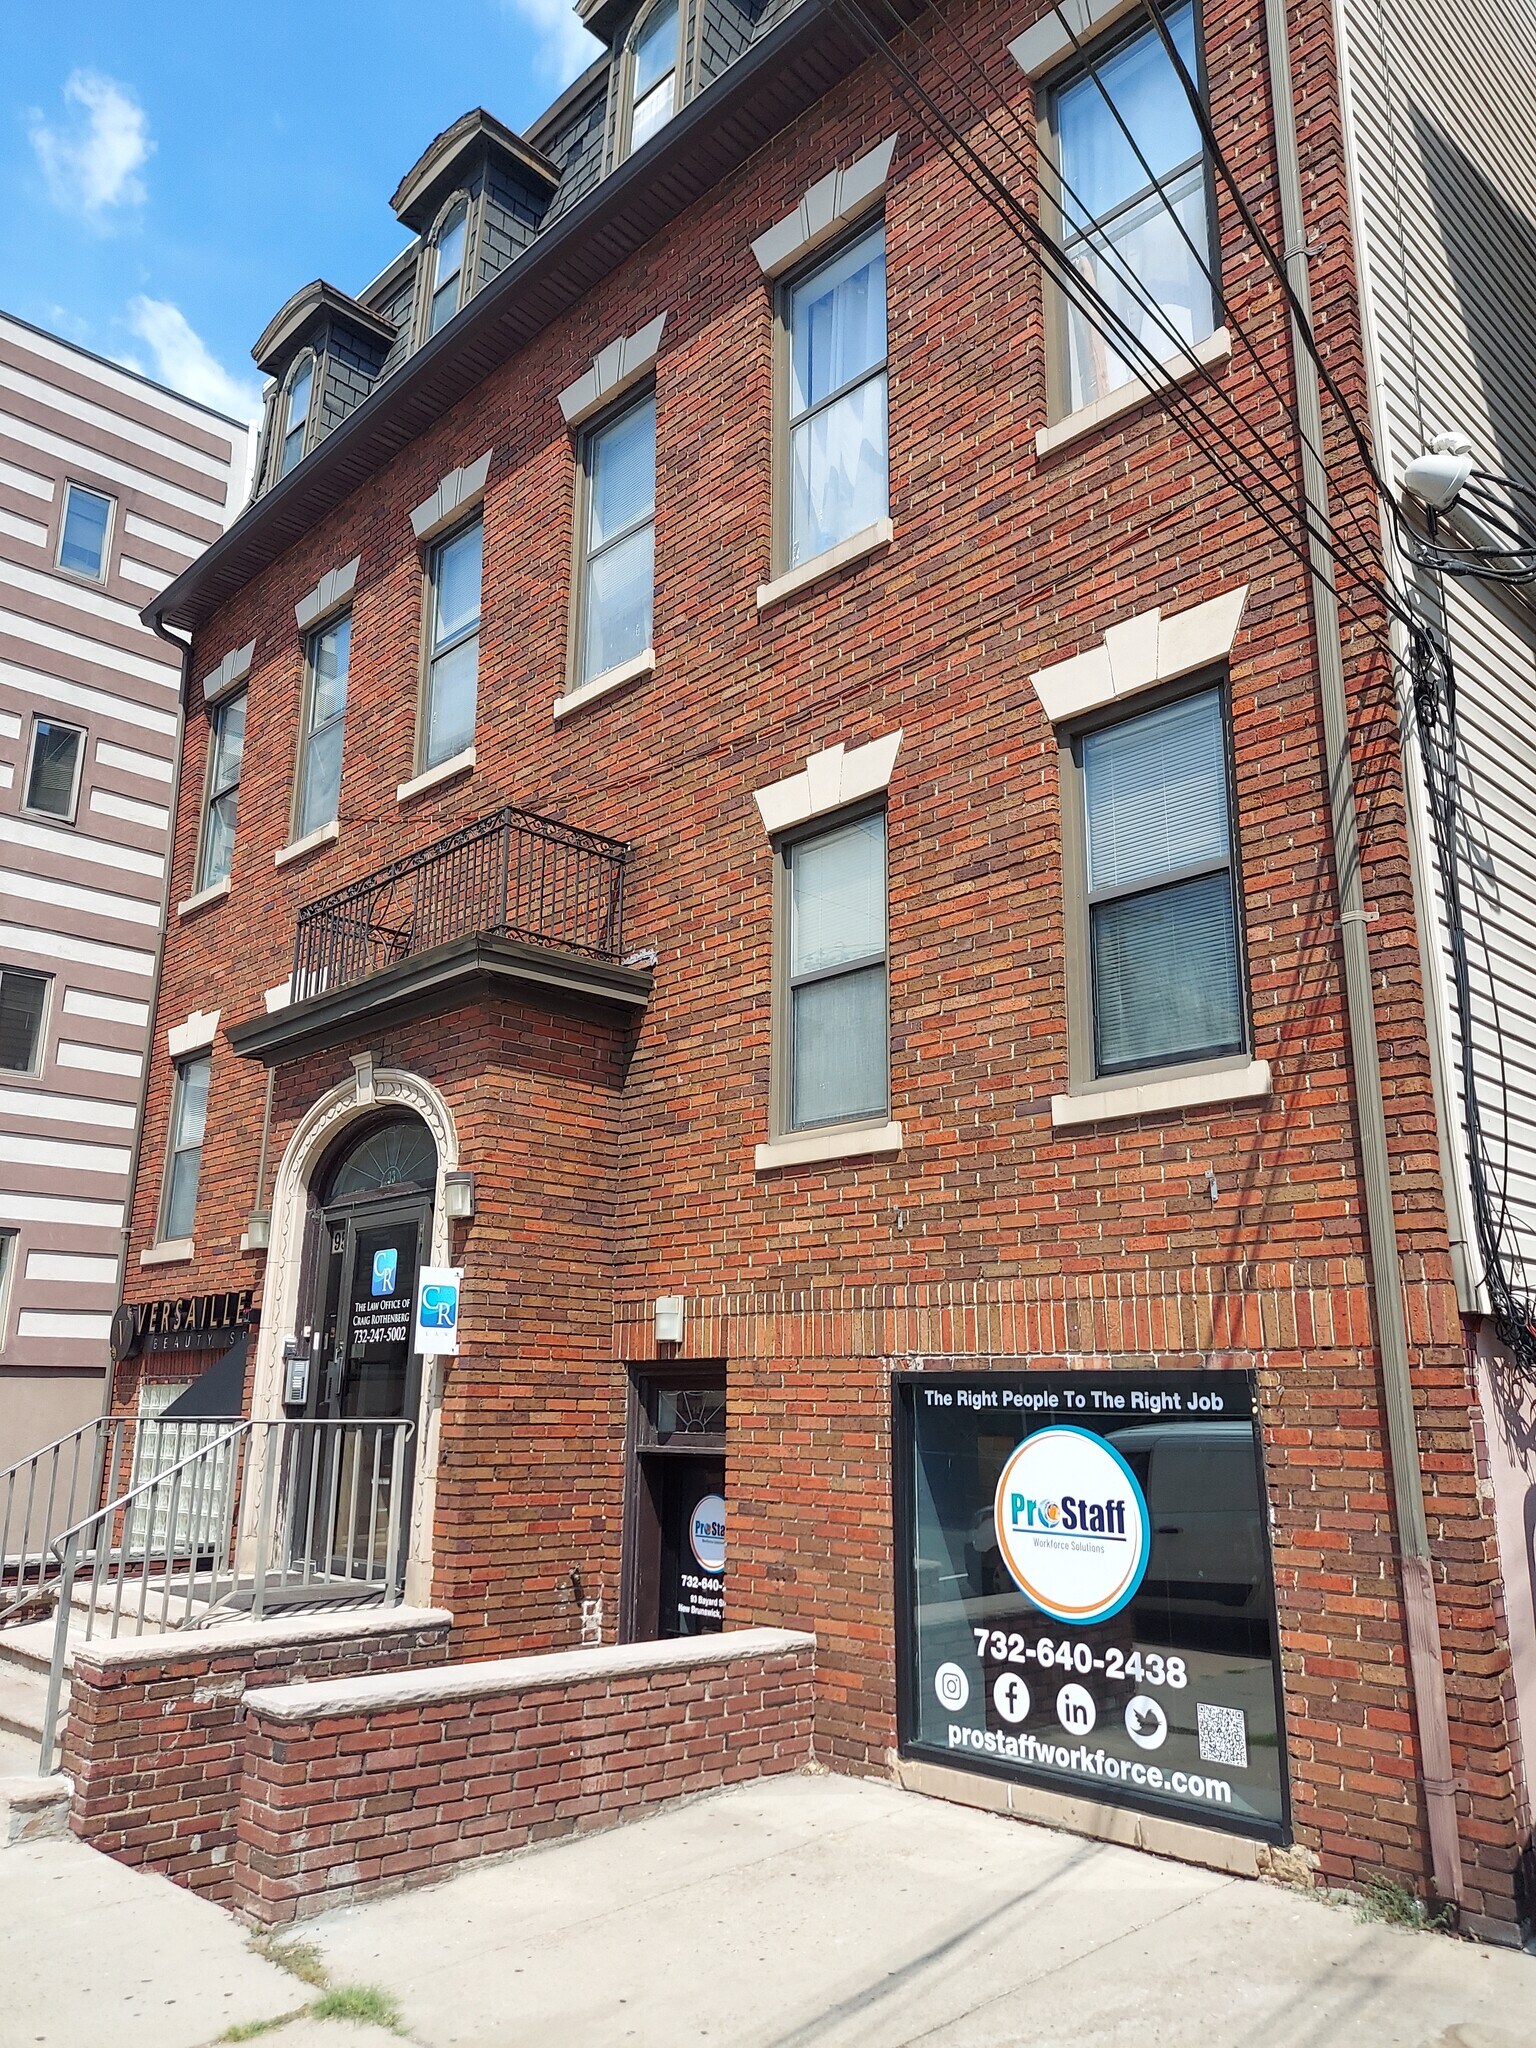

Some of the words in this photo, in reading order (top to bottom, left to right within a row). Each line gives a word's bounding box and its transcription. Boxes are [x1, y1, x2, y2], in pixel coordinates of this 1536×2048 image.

[353, 1315, 370, 1326] CRAIG
[371, 1313, 410, 1325] ROTHENBERG
[152, 1334, 214, 1350] BEAUTY
[354, 1326, 406, 1344] 732-247-5002
[925, 1390, 952, 1407] The
[957, 1389, 998, 1409] Right
[1002, 1391, 1058, 1410] People
[1064, 1390, 1086, 1408] To
[1090, 1391, 1125, 1410] The
[1130, 1391, 1181, 1413] Right
[1187, 1392, 1224, 1412] Job
[1011, 1492, 1126, 1534] ProStaff
[1033, 1537, 1069, 1551] Workforce
[1071, 1541, 1105, 1554] Solutions
[678, 1603, 690, 1613] New
[698, 1595, 718, 1607] Bayard
[974, 1628, 1187, 1689] 732-640-2438
[948, 1724, 1232, 1803] prostaffworkforce.com
